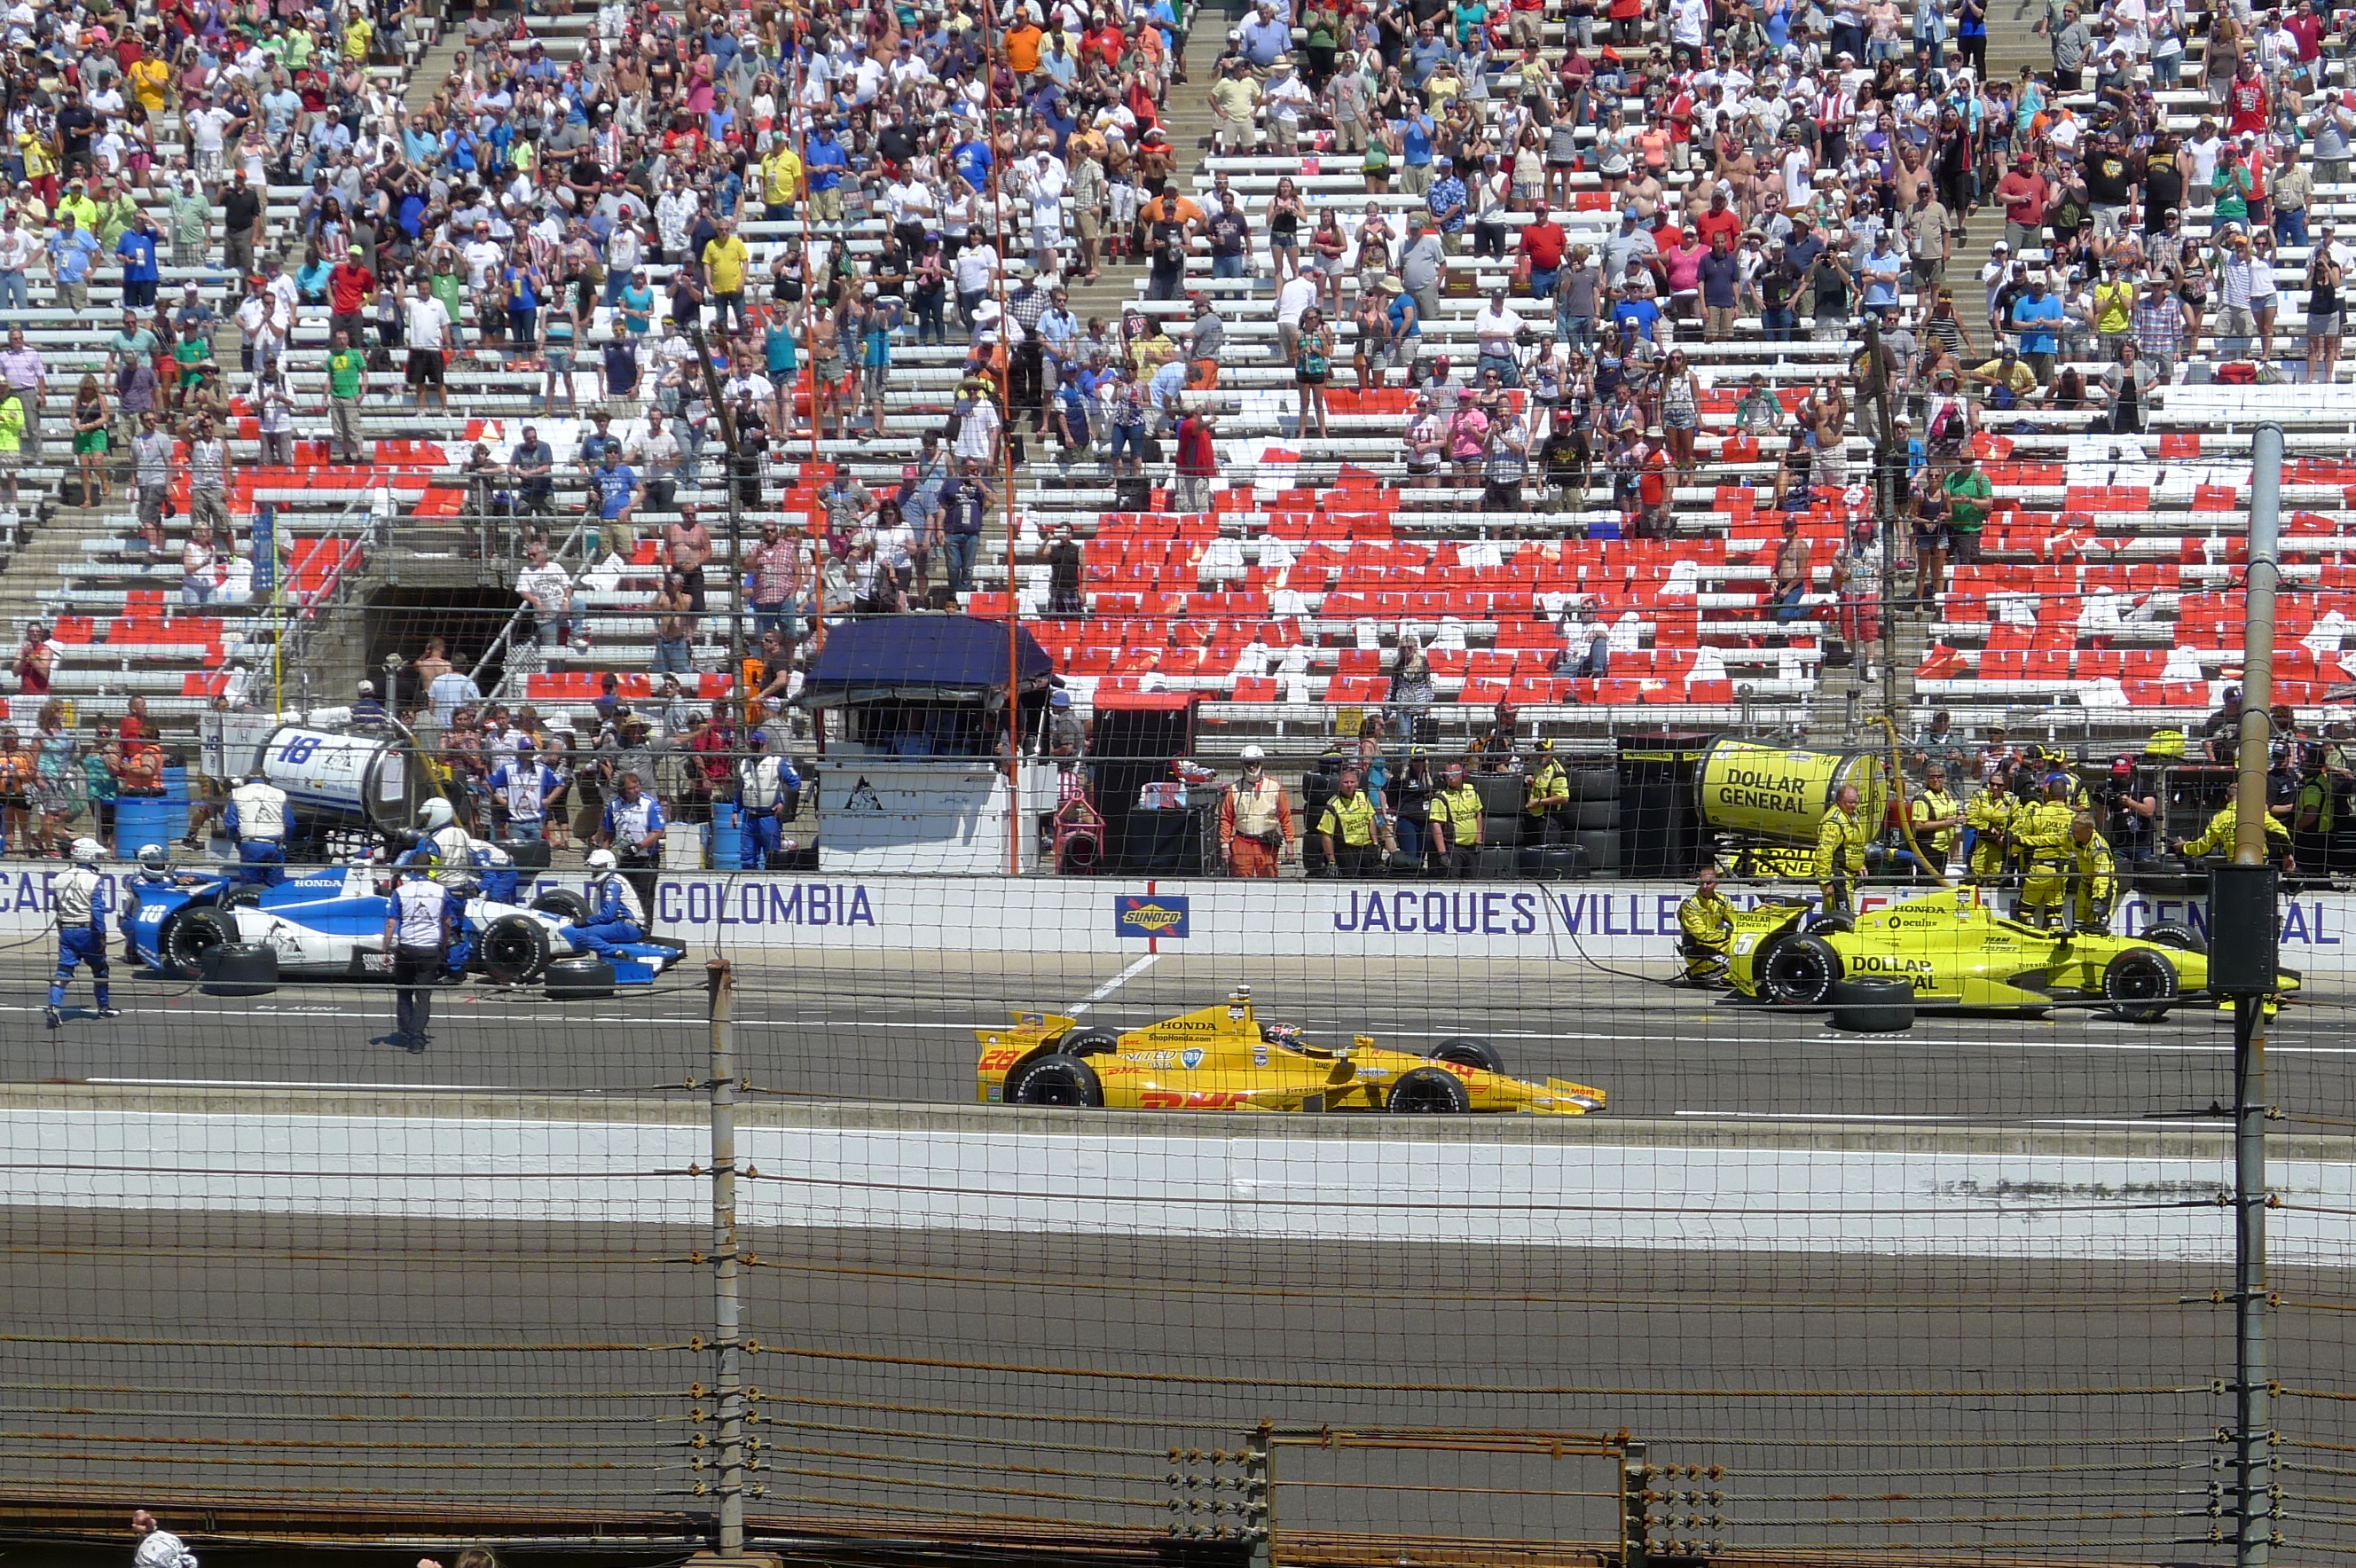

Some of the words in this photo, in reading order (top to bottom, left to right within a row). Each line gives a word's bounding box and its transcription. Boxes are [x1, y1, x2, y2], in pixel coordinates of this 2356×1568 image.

[278, 735, 323, 764] 18
[1727, 769, 1805, 795] DOLLAR
[1719, 787, 1809, 815] GENERAL
[294, 879, 342, 888] HONDA
[659, 882, 876, 926] COLOMBIA
[1893, 905, 1946, 914] HONDA
[1125, 912, 1180, 923] SUNOCO
[1335, 891, 1536, 934] JACQUES
[1739, 914, 1771, 923] DOLLAR
[1902, 919, 1938, 928] oculus
[1732, 932, 1759, 956] 5
[1852, 957, 1933, 973] DOLLAR
[1159, 1022, 1219, 1031] HONDA
[1148, 1033, 1212, 1043] ShopHonda.com
[978, 1049, 1021, 1070] 28
[1286, 1086, 1328, 1094] Firestone
[1138, 1092, 1249, 1109] DHL
